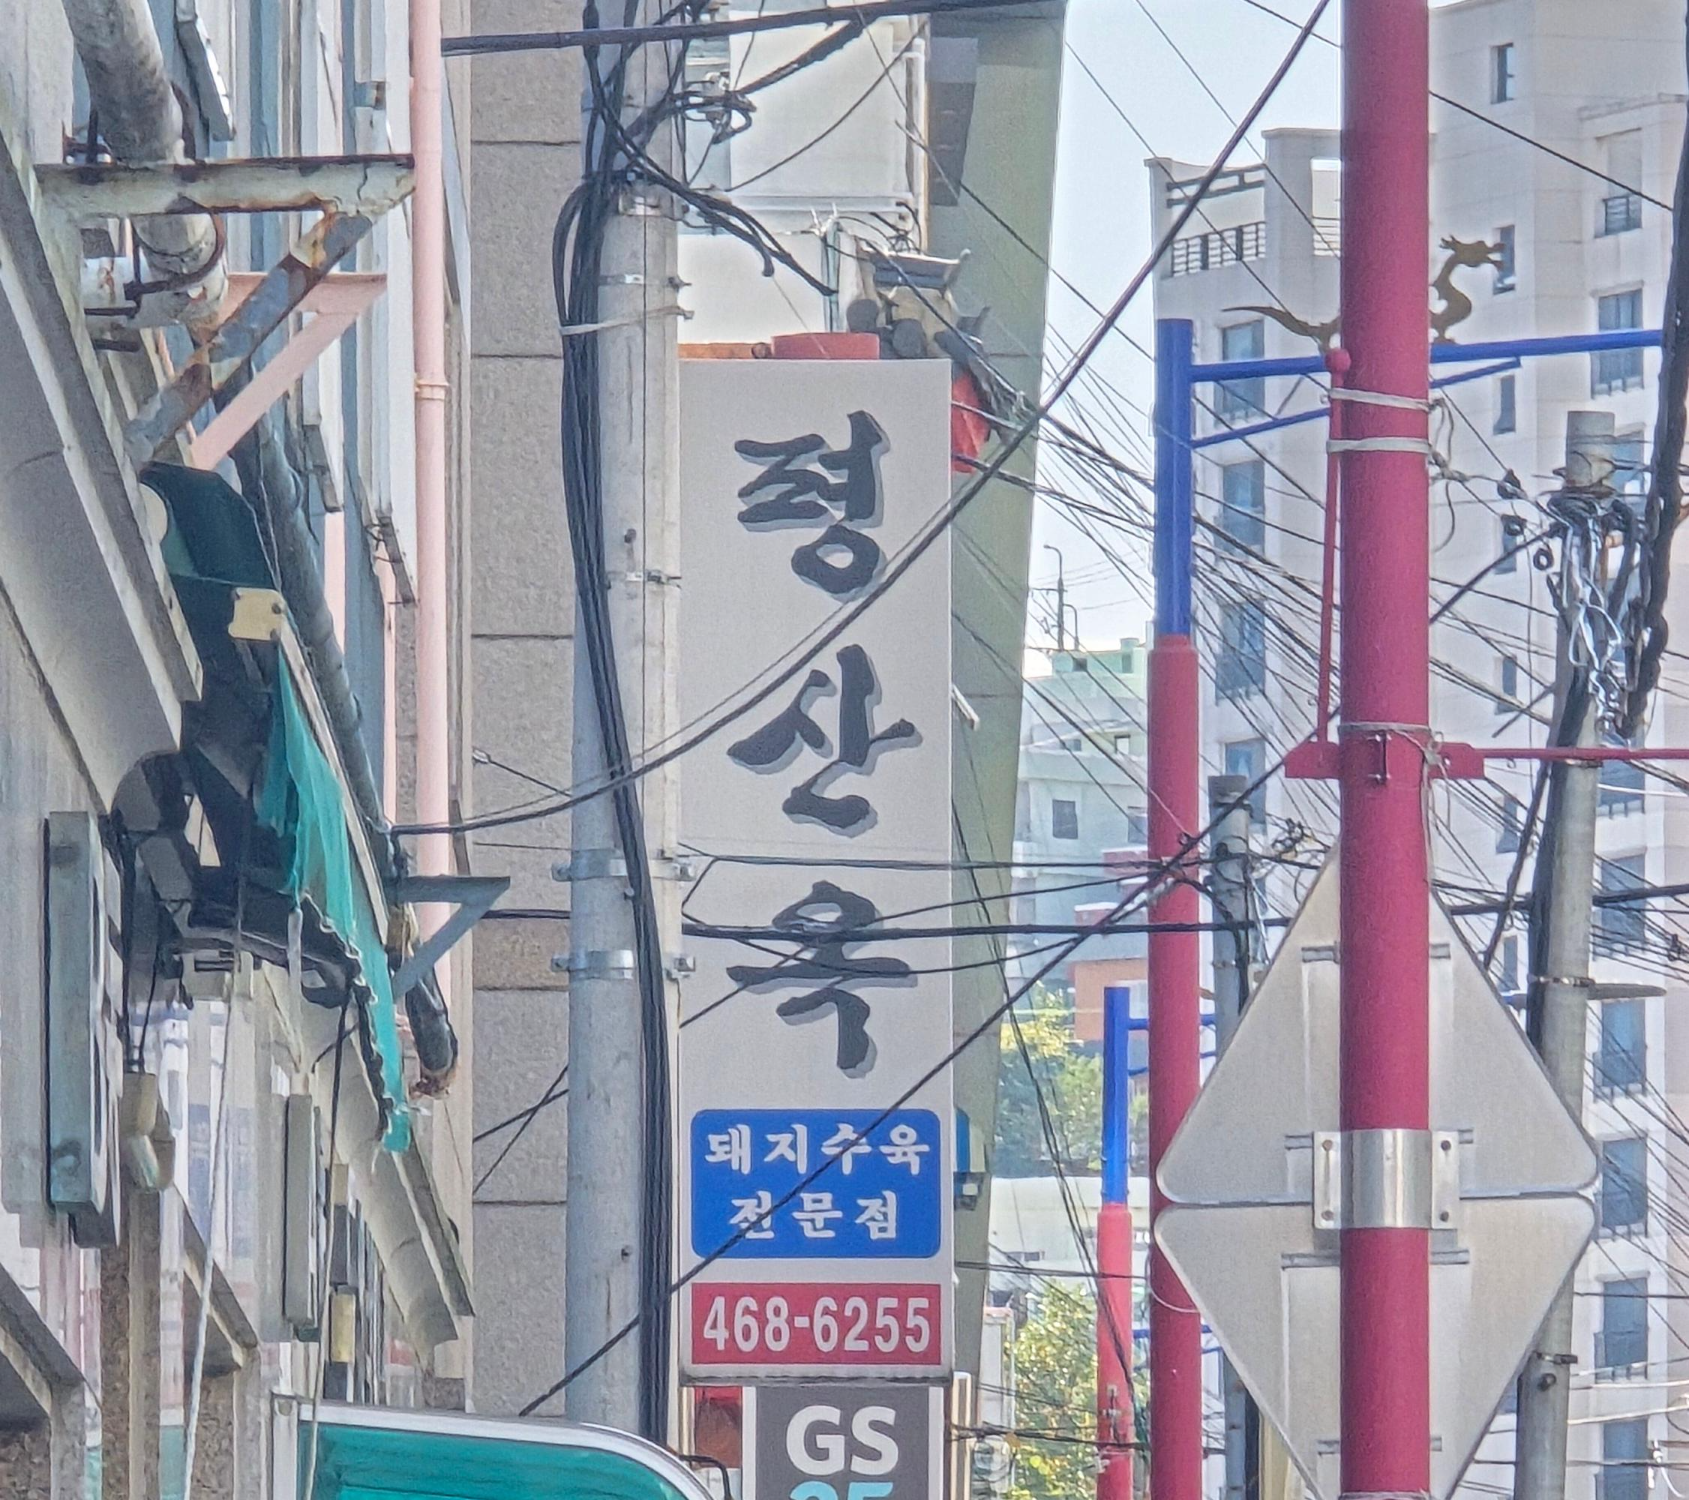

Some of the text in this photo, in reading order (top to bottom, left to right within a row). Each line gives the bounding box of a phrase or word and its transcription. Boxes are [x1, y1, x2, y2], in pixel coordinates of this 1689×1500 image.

[726, 410, 921, 1077] 평산옥
[704, 1123, 930, 1176] 돼지수육
[729, 1189, 898, 1240] 전문점
[703, 1296, 931, 1352] 468-6255
[785, 1405, 899, 1476] GS
